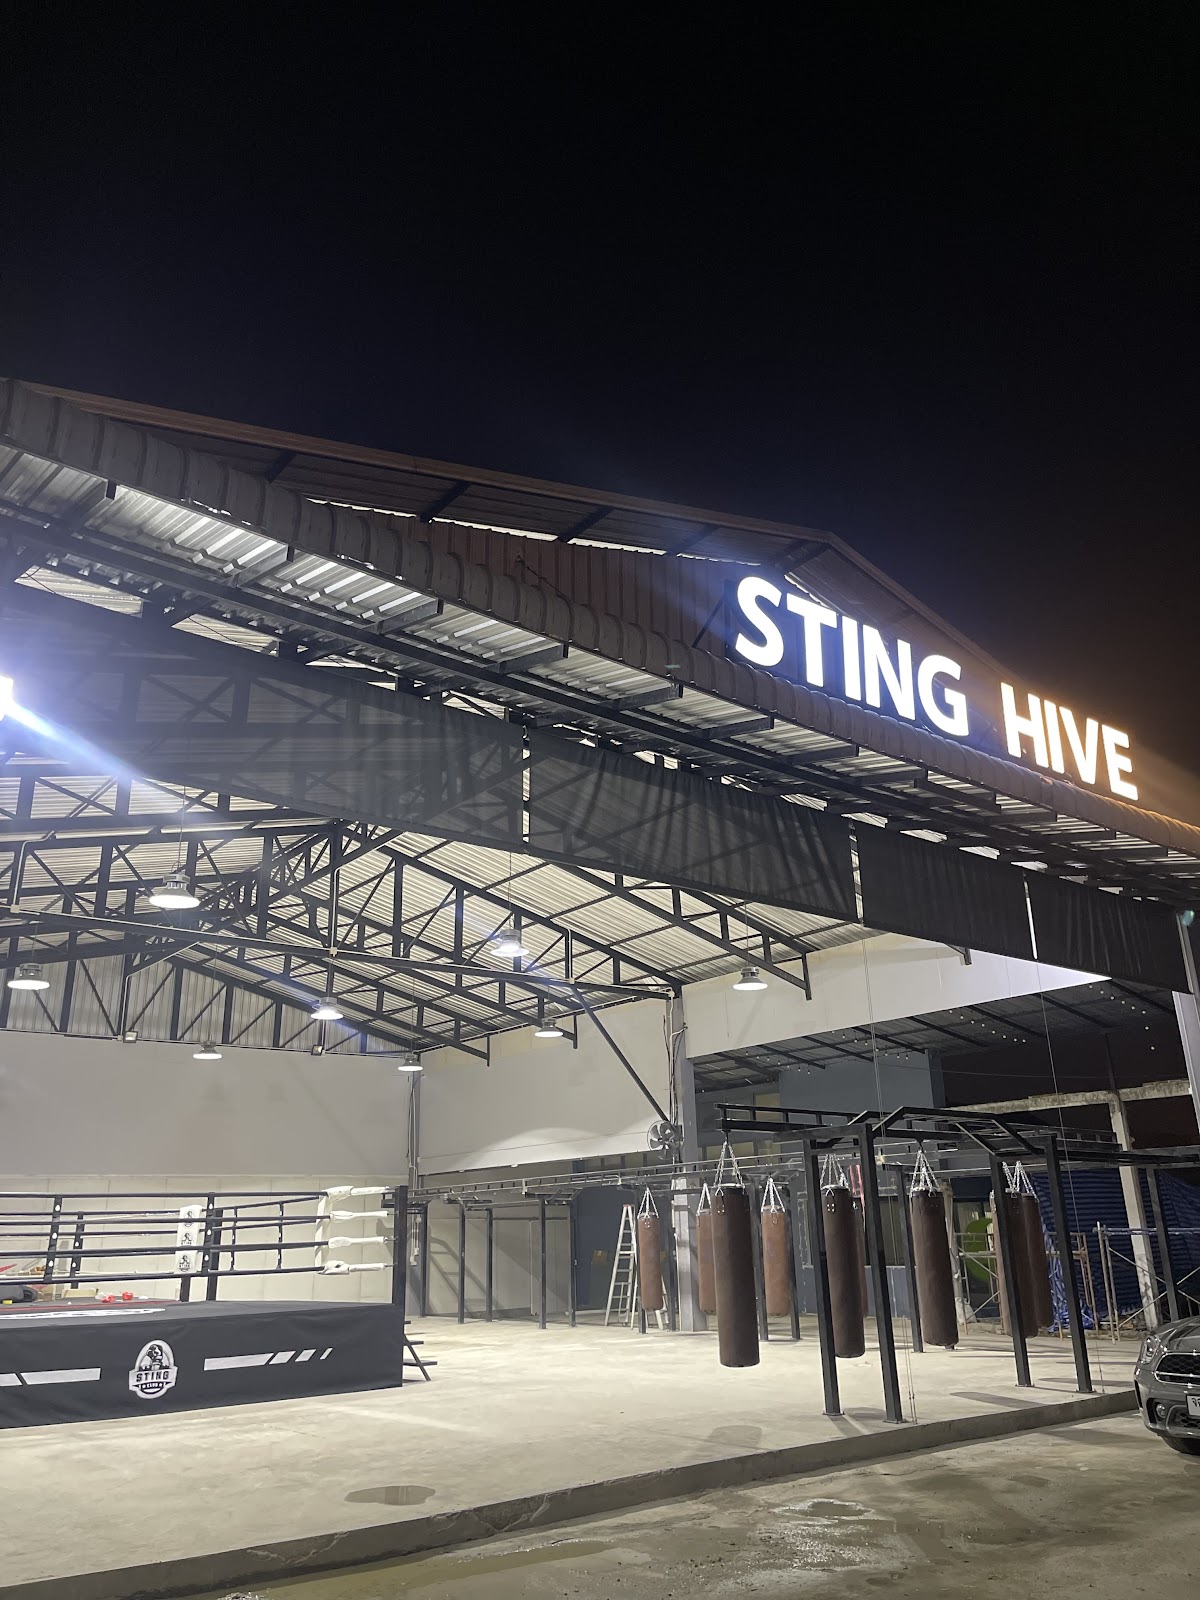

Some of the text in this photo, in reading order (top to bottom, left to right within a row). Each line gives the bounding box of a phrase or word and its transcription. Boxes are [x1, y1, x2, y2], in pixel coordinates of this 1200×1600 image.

[735, 576, 1139, 801] STING HIVE
[136, 1371, 169, 1382] STING
